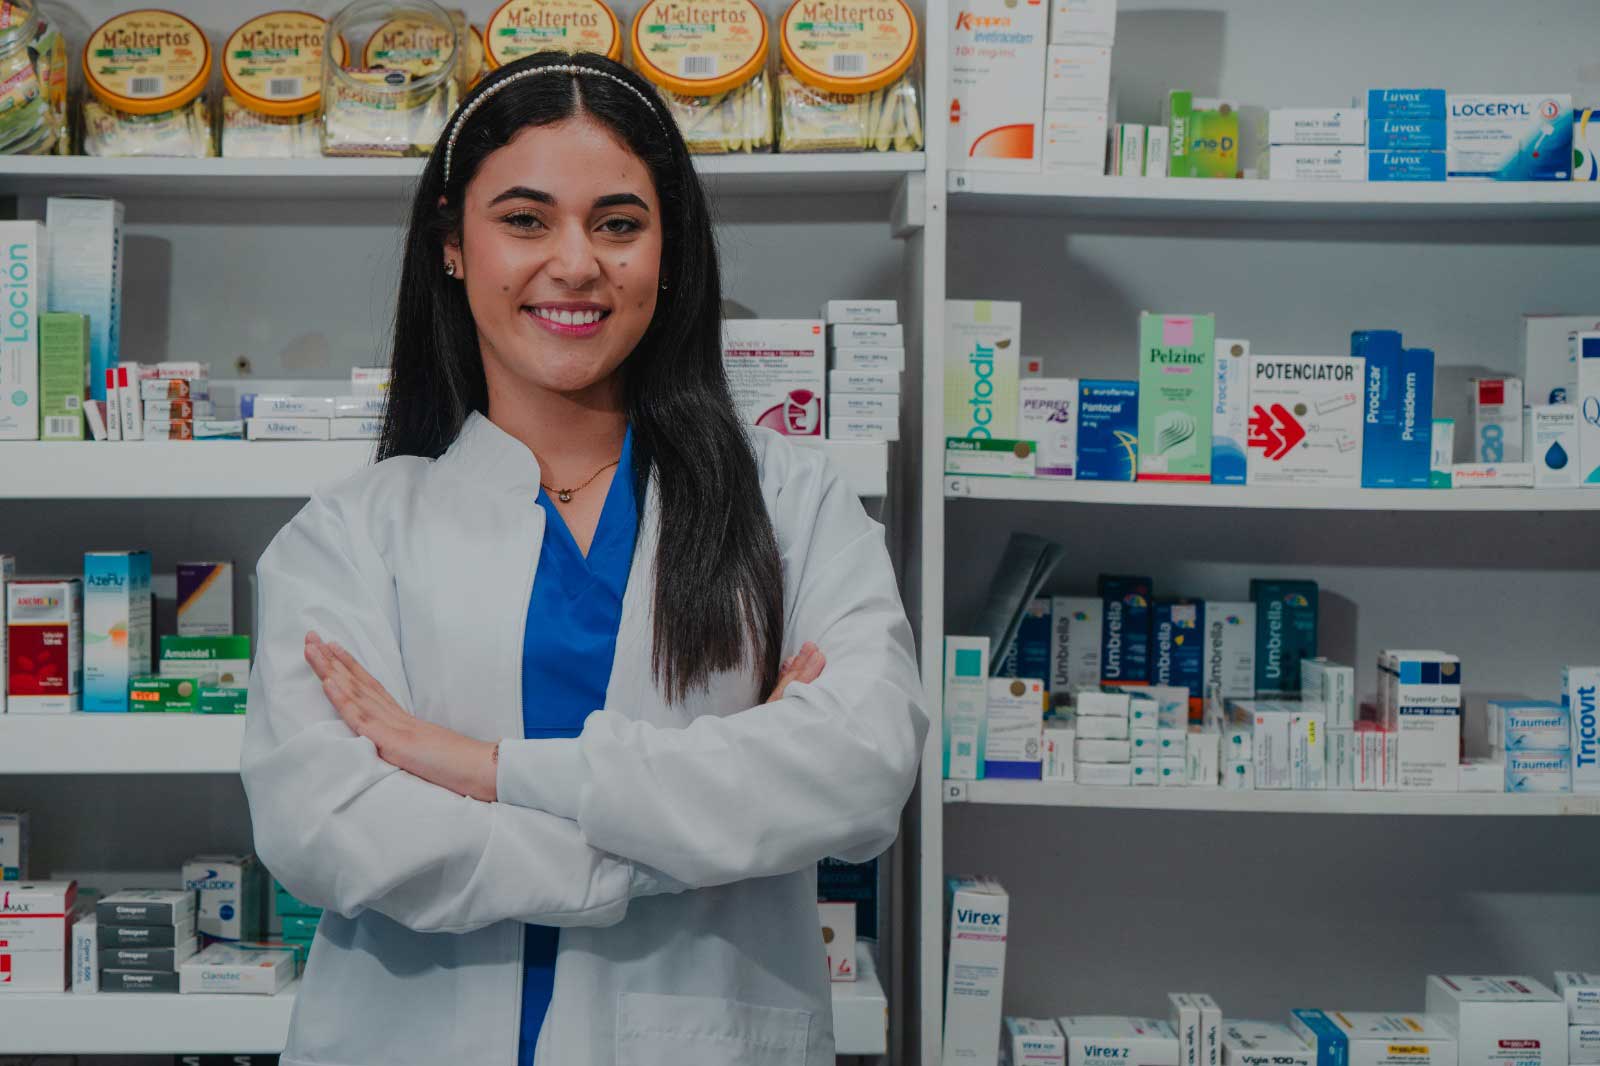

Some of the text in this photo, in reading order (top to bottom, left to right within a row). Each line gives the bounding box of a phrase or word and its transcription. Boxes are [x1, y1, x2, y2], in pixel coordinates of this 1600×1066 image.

[1383, 90, 1421, 102] Luvox
[1453, 102, 1529, 117] LOCERYL
[1384, 122, 1421, 133] Luvox
[1383, 154, 1421, 165] Luvox
[3, 243, 29, 343] Loción
[1150, 349, 1205, 365] Pelzinc
[1256, 363, 1354, 381] POTENCIATOR
[1082, 402, 1121, 413] Pantocal
[1402, 372, 1416, 441] Presiderm
[951, 481, 959, 491] C
[1106, 601, 1122, 678] Umbrella
[1266, 601, 1282, 679] Umbrella
[1055, 616, 1070, 686] Umbrella
[1157, 622, 1172, 685] mbrella
[1577, 685, 1596, 768] Tricovit
[951, 787, 960, 796] D
[957, 909, 1000, 926] Virex
[1084, 1046, 1118, 1057] Virex
